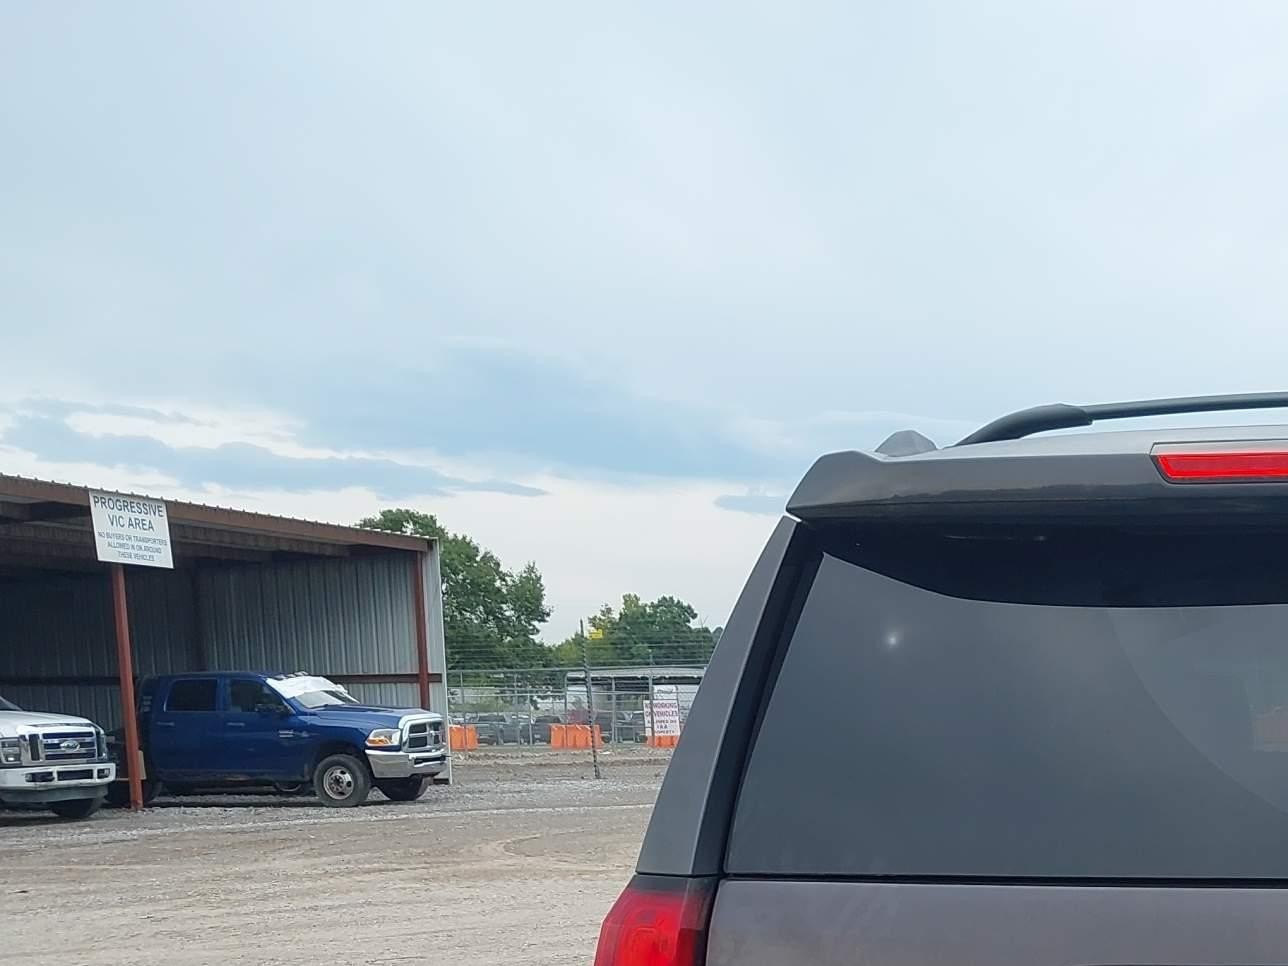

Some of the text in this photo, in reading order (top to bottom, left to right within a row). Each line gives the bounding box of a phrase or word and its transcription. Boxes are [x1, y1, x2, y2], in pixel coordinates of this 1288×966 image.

[92, 495, 164, 518] PROGRESSIVE
[108, 513, 155, 532] VIC AREA
[106, 532, 124, 540] BUYERS
[125, 534, 132, 542] OR
